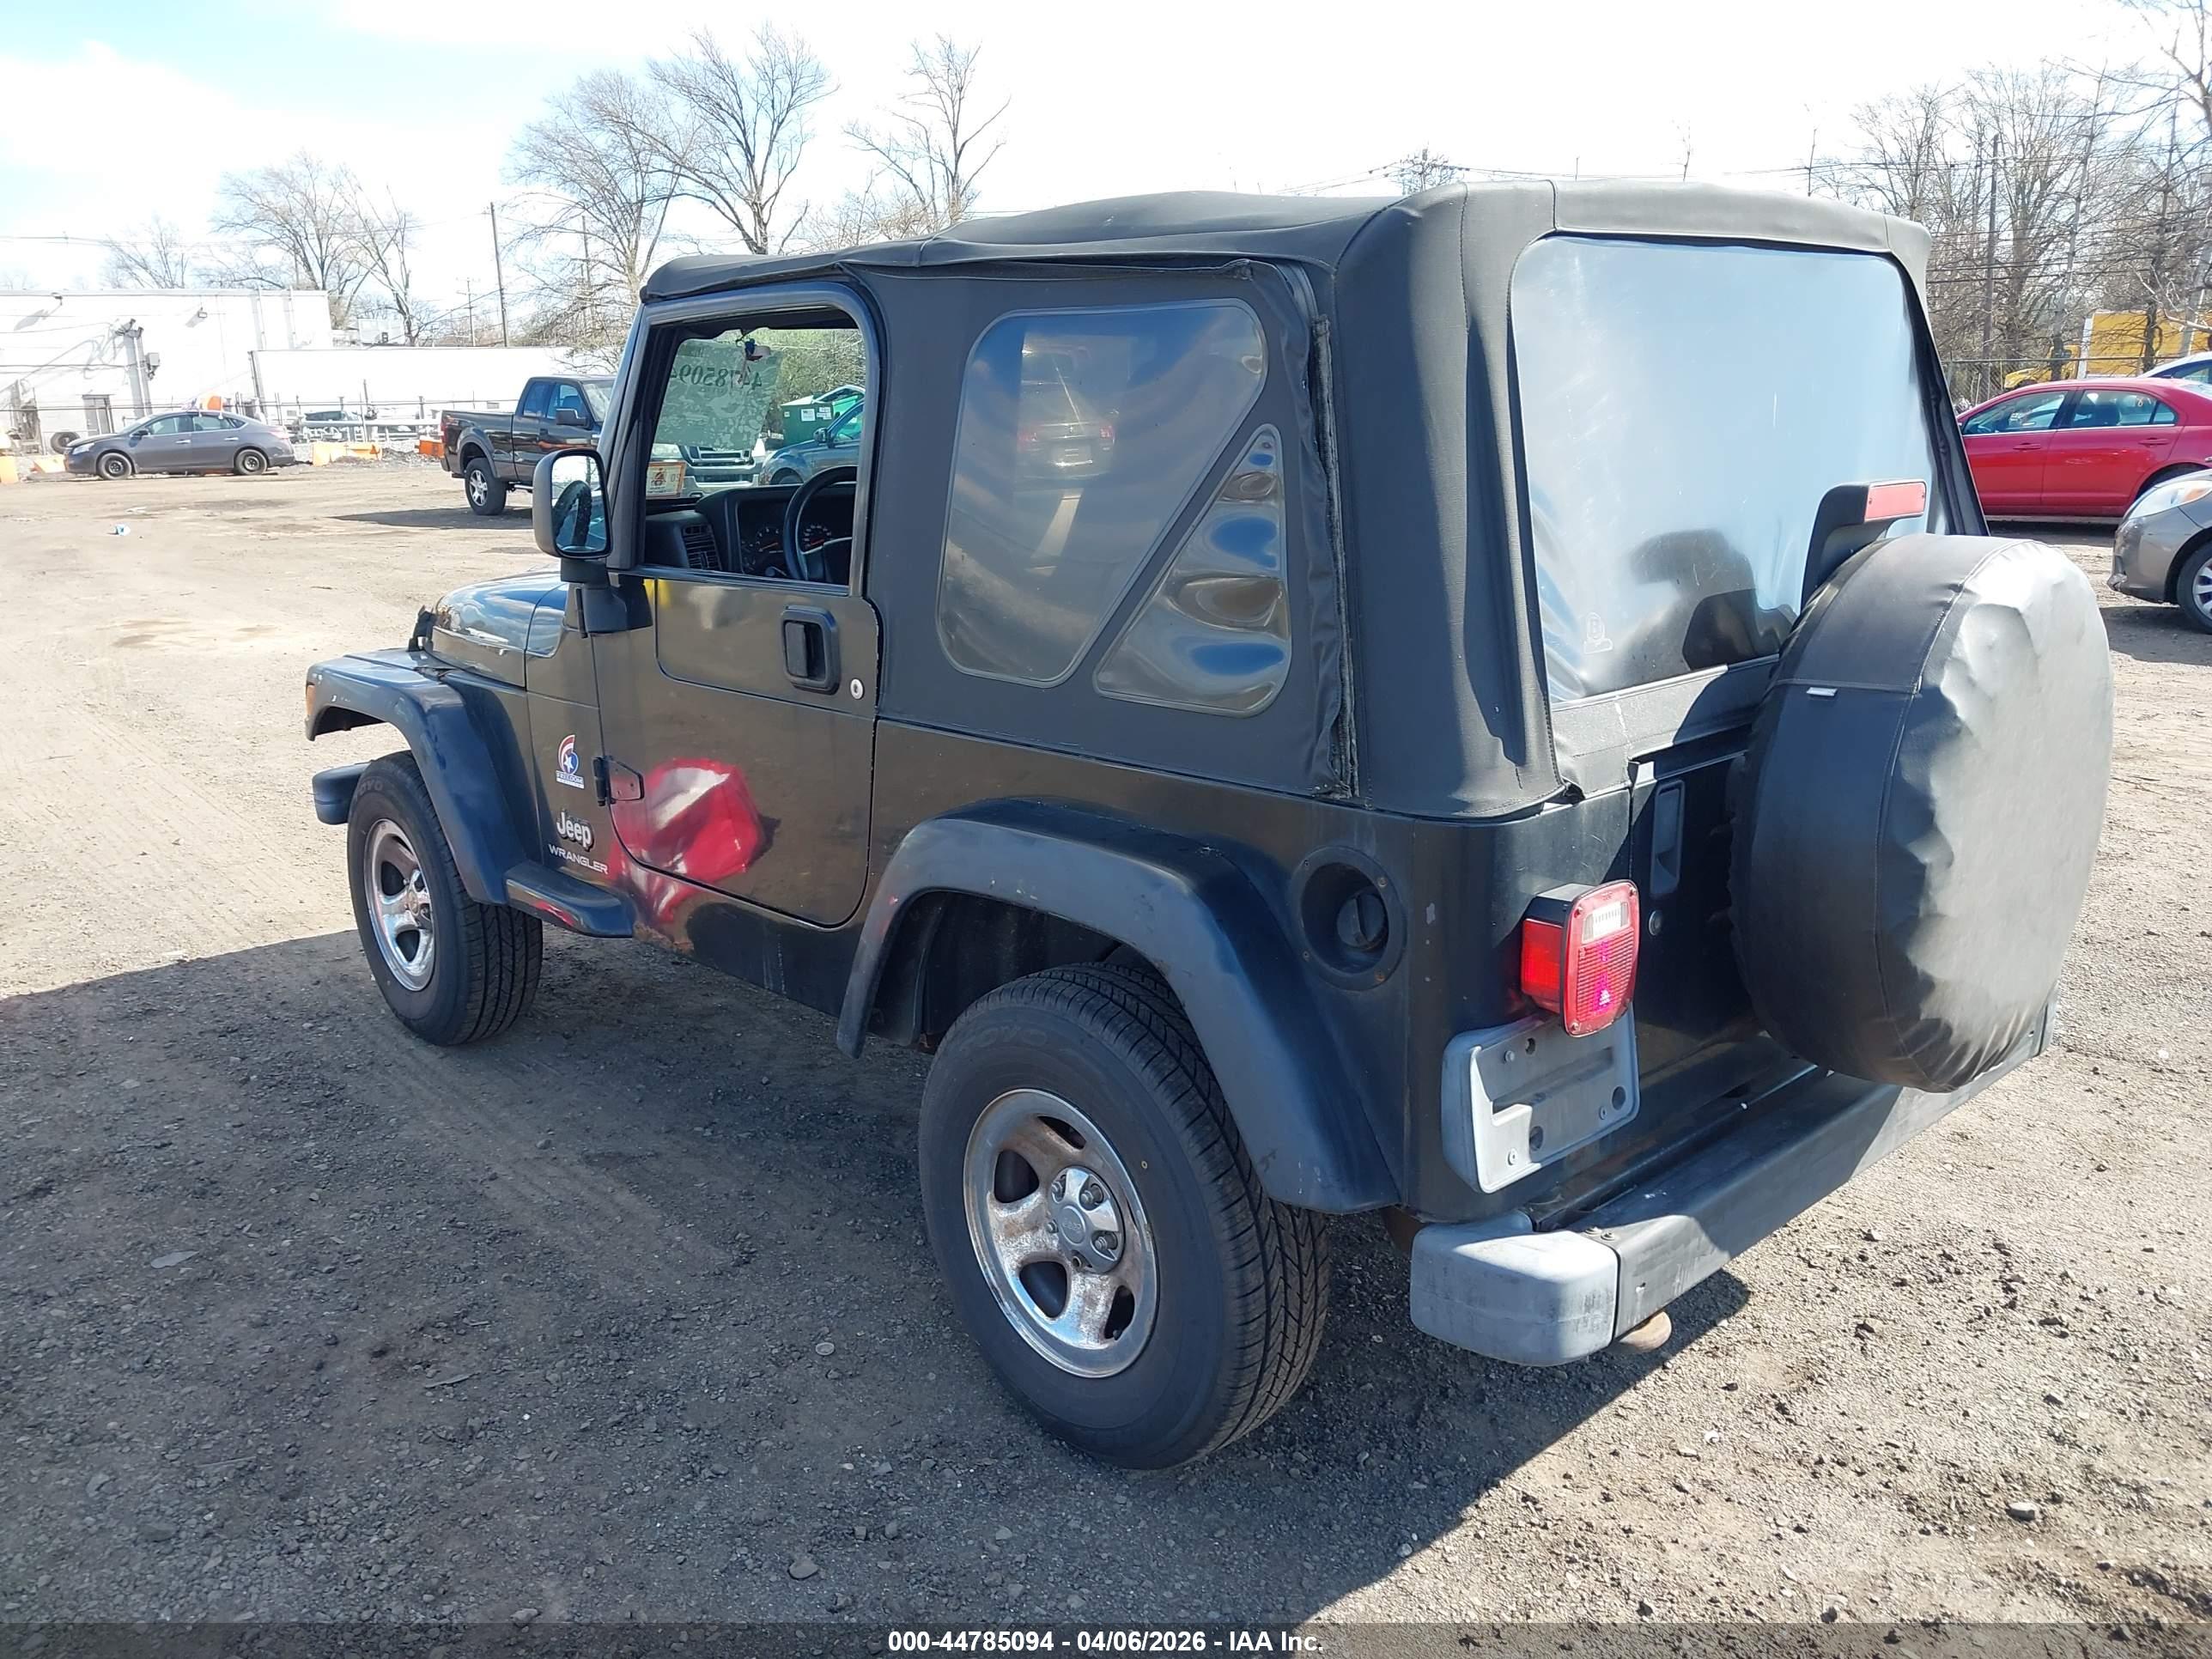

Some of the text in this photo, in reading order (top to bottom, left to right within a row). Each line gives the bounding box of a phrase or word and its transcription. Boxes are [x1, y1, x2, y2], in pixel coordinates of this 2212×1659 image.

[556, 769, 584, 783] FREEDOM
[556, 811, 593, 848] Jeep
[548, 843, 609, 874] WRANGLER
